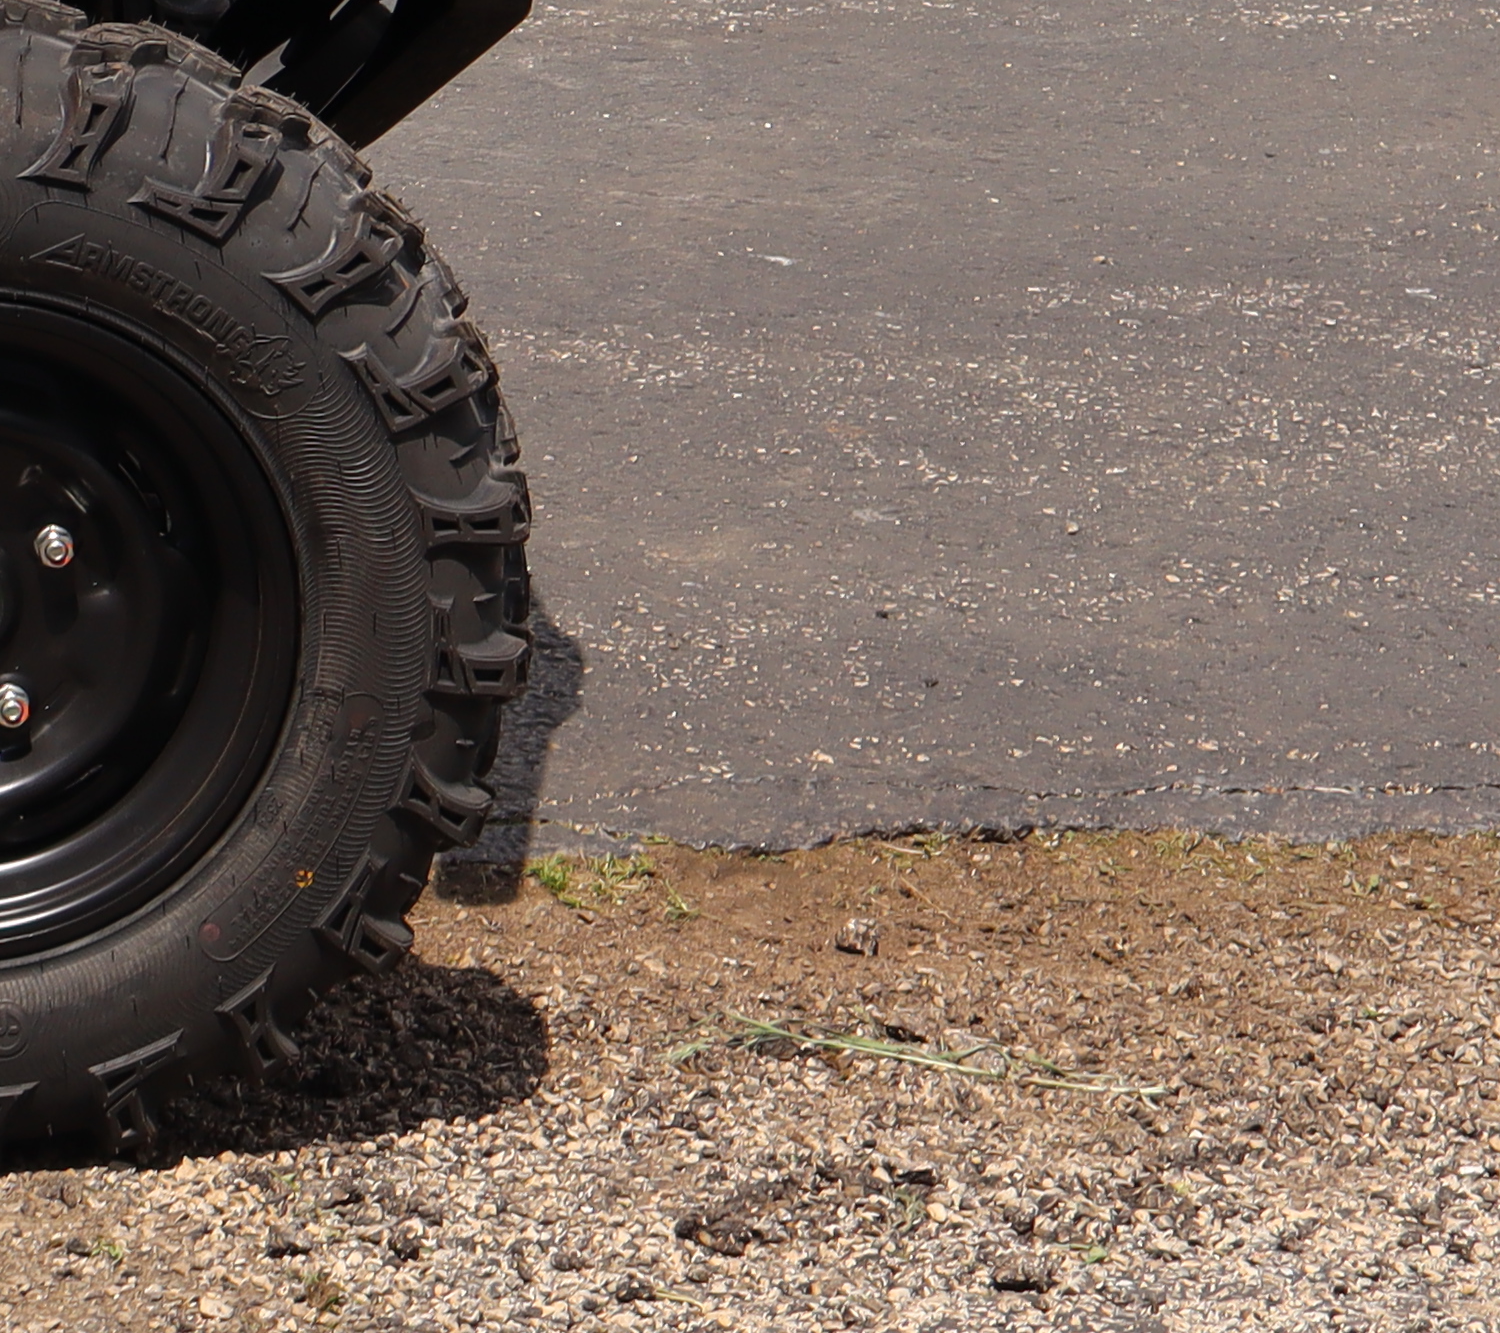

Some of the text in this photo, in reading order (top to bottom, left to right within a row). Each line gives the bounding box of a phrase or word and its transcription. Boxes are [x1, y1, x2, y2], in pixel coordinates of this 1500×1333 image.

[28, 230, 257, 360] ARMSTRONG
[299, 768, 332, 818] MADE
[280, 792, 337, 873] TUBELESS
[288, 818, 306, 836] IN
[253, 837, 294, 884] CHINA
